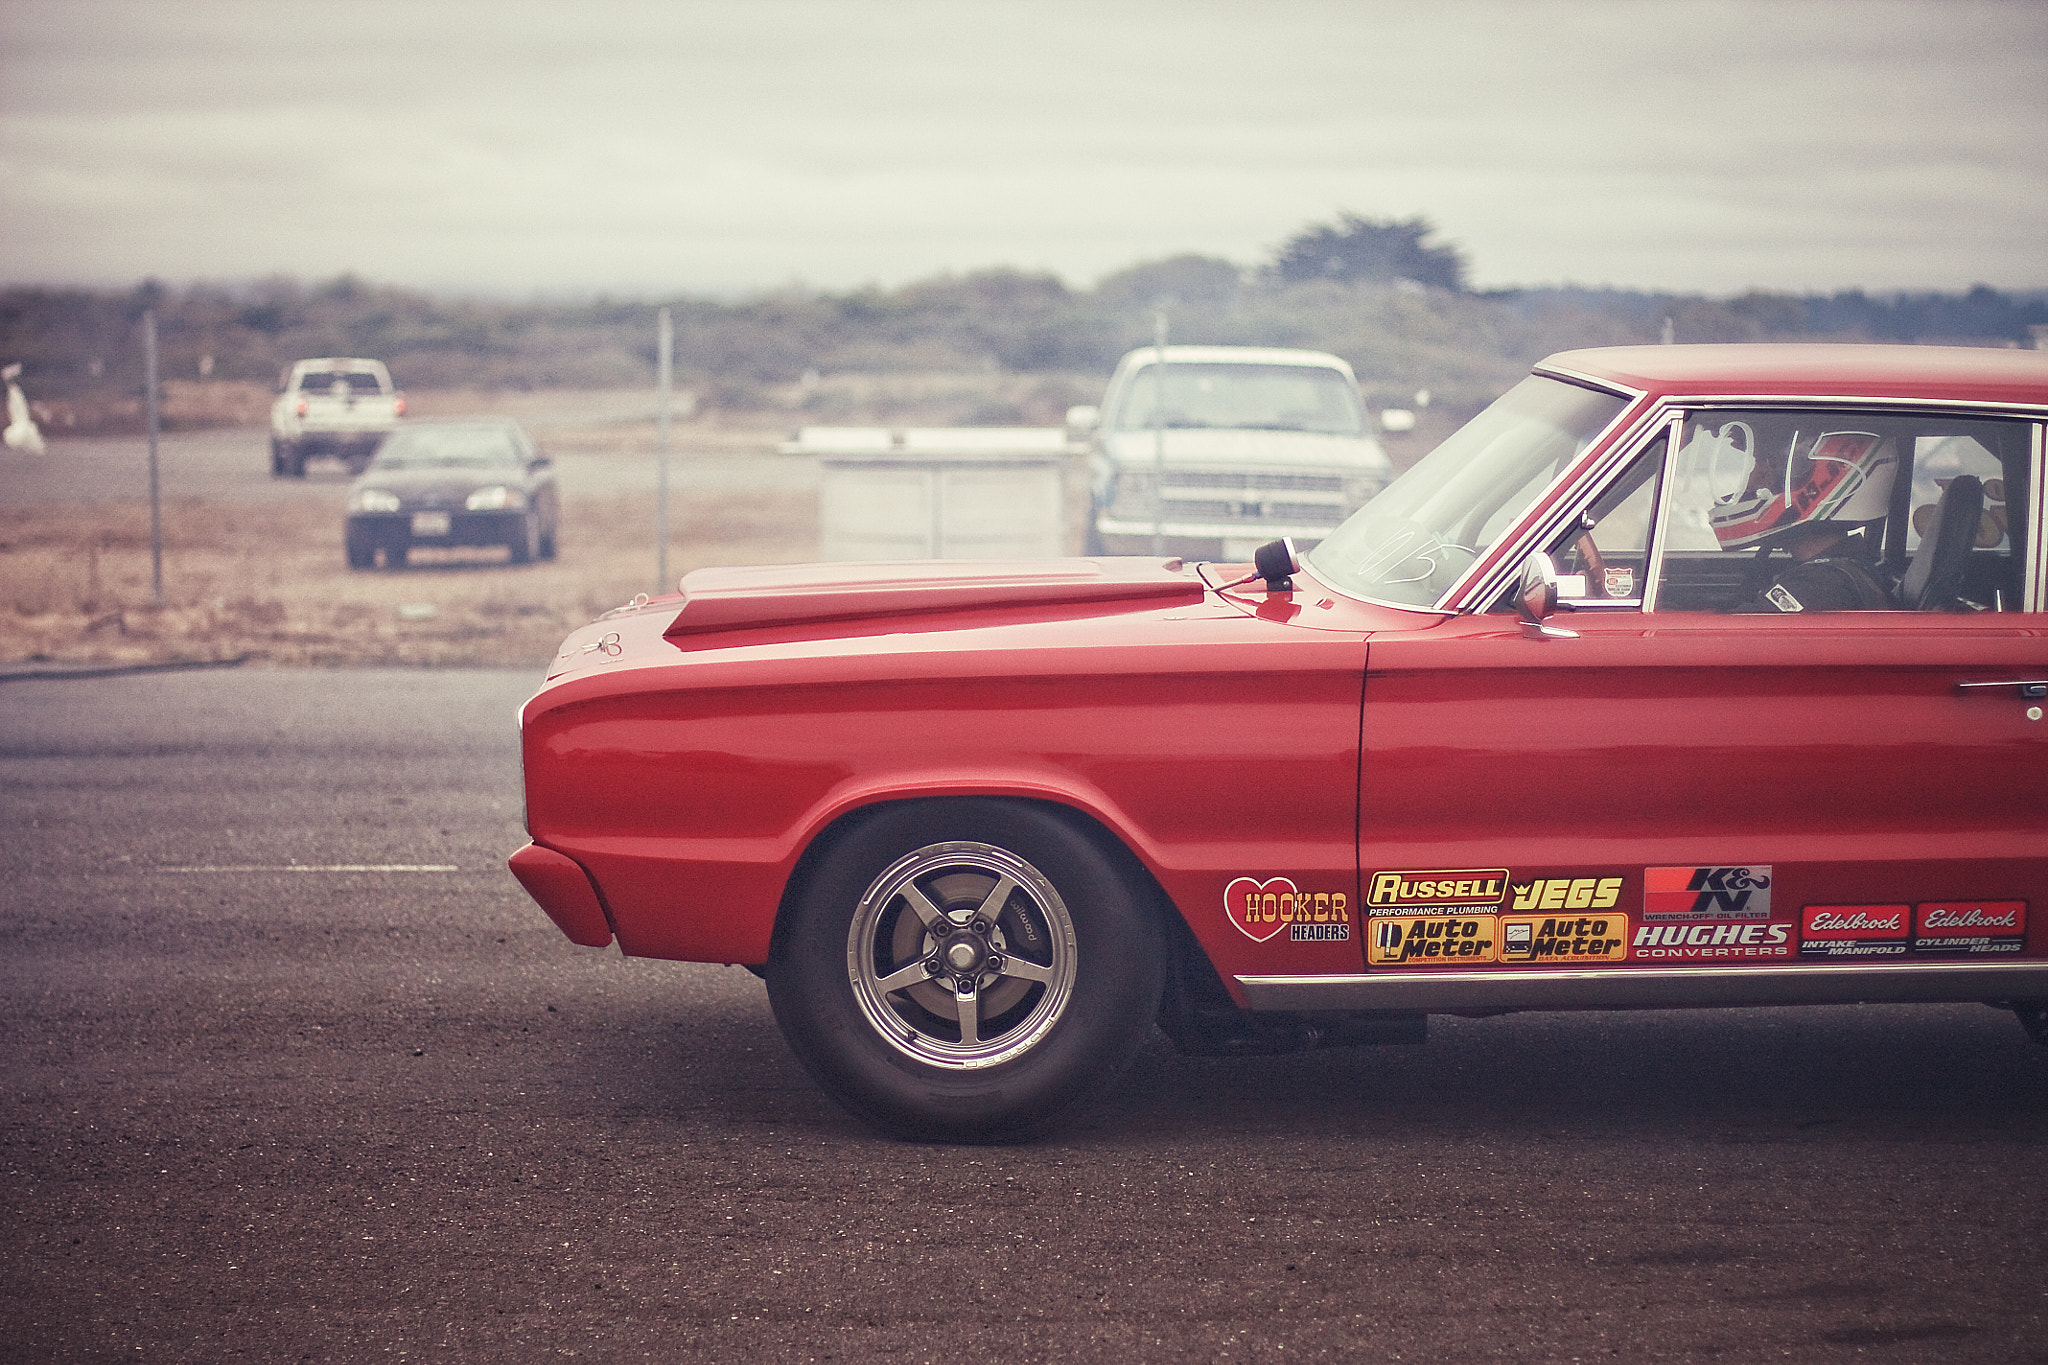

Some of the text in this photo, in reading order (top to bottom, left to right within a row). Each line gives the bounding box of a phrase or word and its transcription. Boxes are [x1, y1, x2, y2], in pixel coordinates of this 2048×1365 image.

[1373, 874, 1500, 903] RUSSELL
[1513, 878, 1622, 910] JEGS
[1245, 892, 1349, 923] HOOKER
[1369, 905, 1498, 916] PERFORMANCE PLUMBING
[1010, 900, 1037, 941] wilwood
[1537, 918, 1608, 937] Auto
[1810, 912, 1900, 931] Edelbrock
[1924, 909, 2015, 928] Edelbrock
[1291, 923, 1349, 941] HEADERS
[1407, 919, 1478, 938] Auto
[1632, 924, 1793, 946] HUGHES
[1400, 938, 1492, 959] Meter
[1531, 937, 1621, 958] Meter
[1636, 946, 1788, 957] CONVERTERS
[1802, 940, 1857, 948] INTAKE
[1827, 945, 1906, 955] MANIFOLD
[1915, 937, 1990, 947] CYLINDER
[1969, 942, 2021, 952] HEADS
